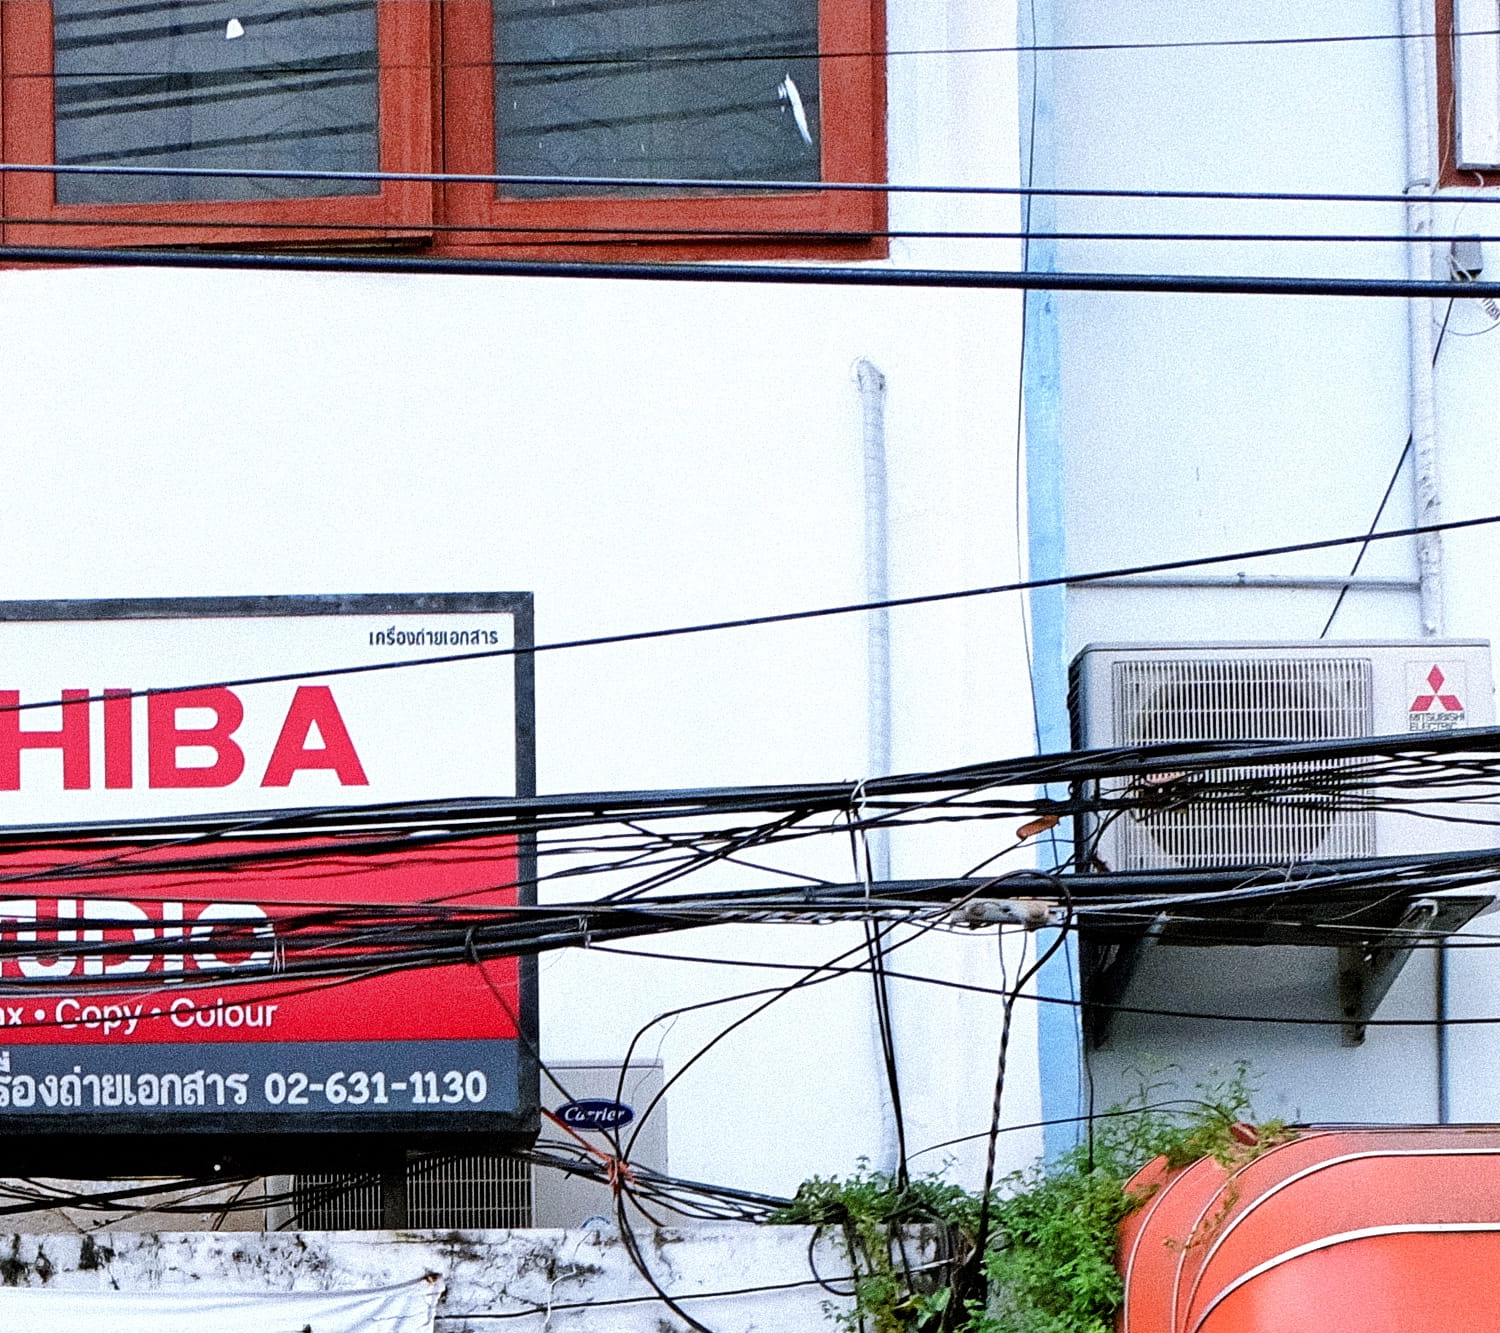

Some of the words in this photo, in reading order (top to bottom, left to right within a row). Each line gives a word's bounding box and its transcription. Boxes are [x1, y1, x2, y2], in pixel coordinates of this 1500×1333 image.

[369, 626, 498, 646] เครื่องถ่ายเอกสาร
[55, 998, 141, 1035] Copy
[170, 996, 279, 1030] Colour
[264, 1069, 488, 1105] 02-631-1130
